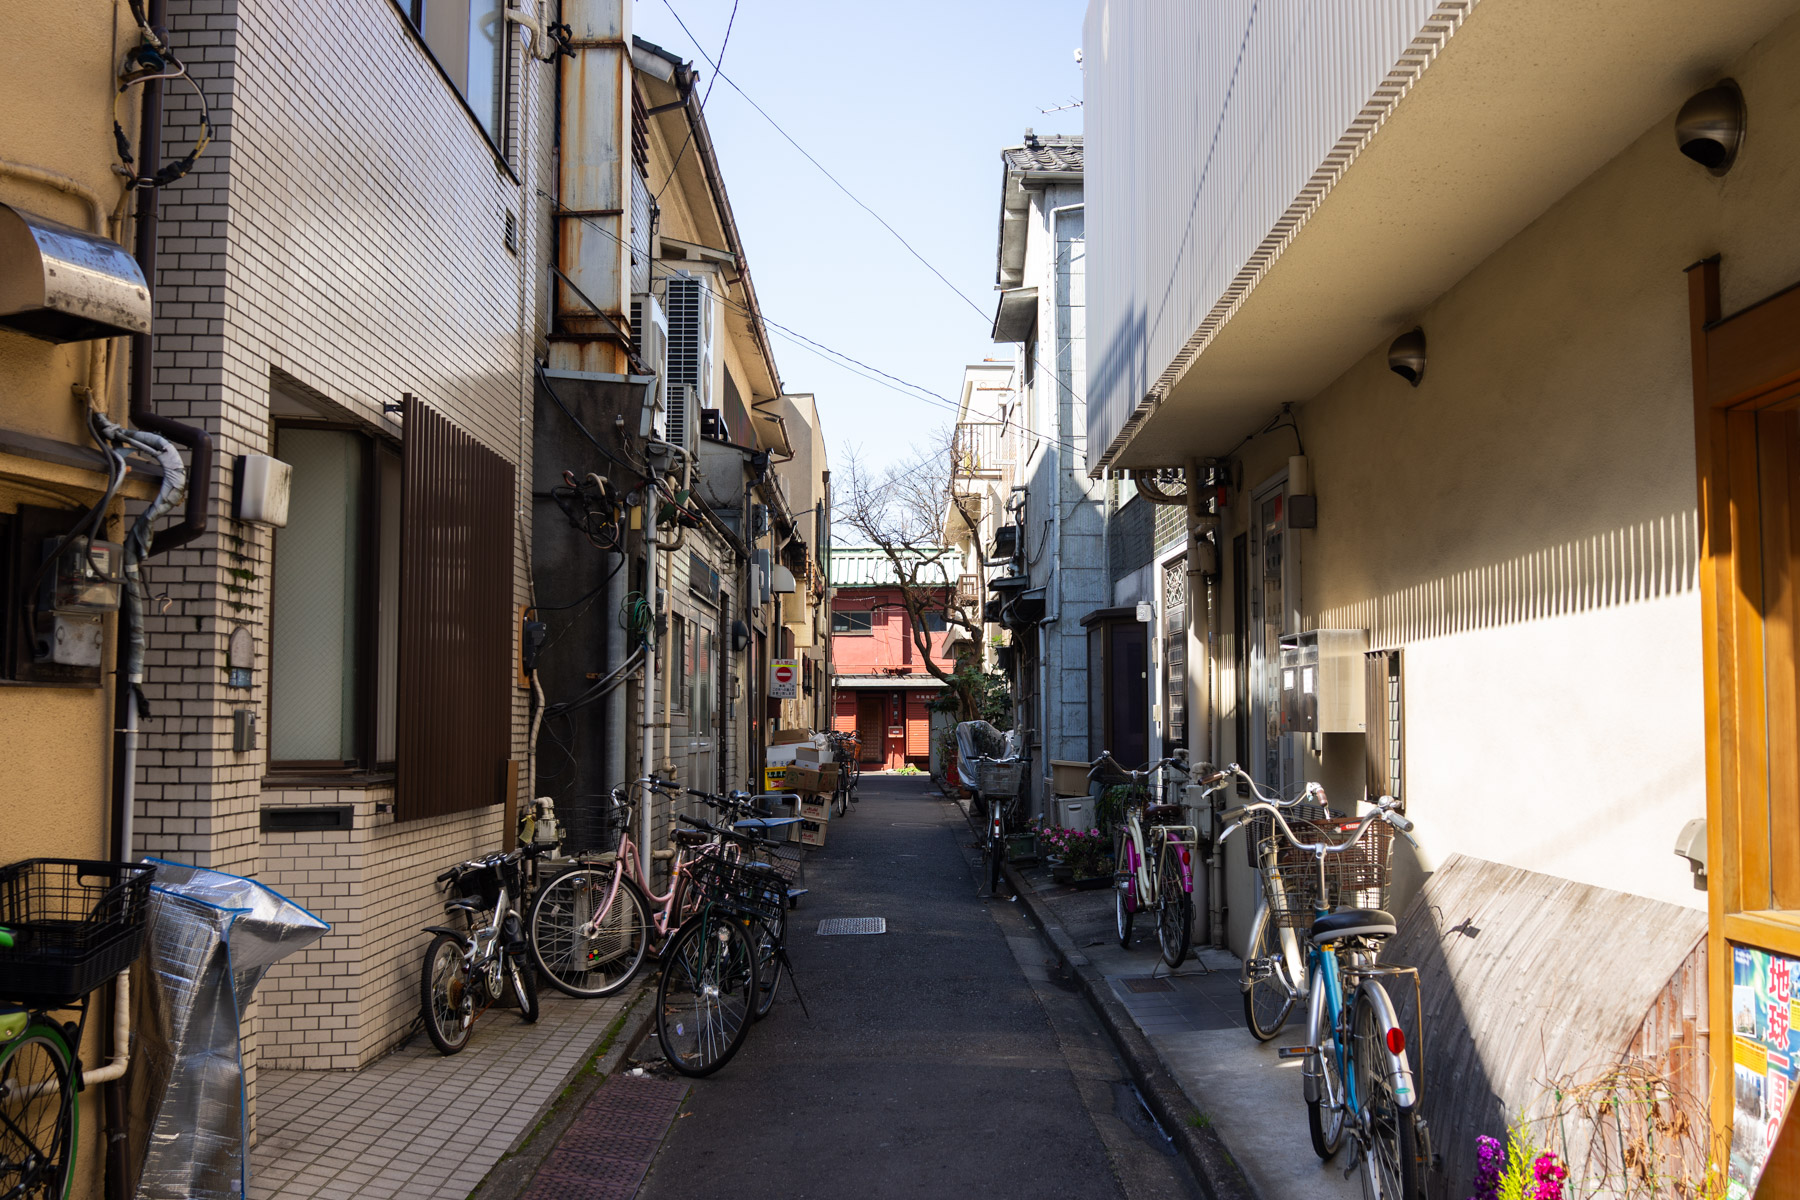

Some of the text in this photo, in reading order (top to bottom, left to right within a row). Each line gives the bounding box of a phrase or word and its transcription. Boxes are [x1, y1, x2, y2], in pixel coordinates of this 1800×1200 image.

[1763, 956, 1789, 1167] 地球一周の
